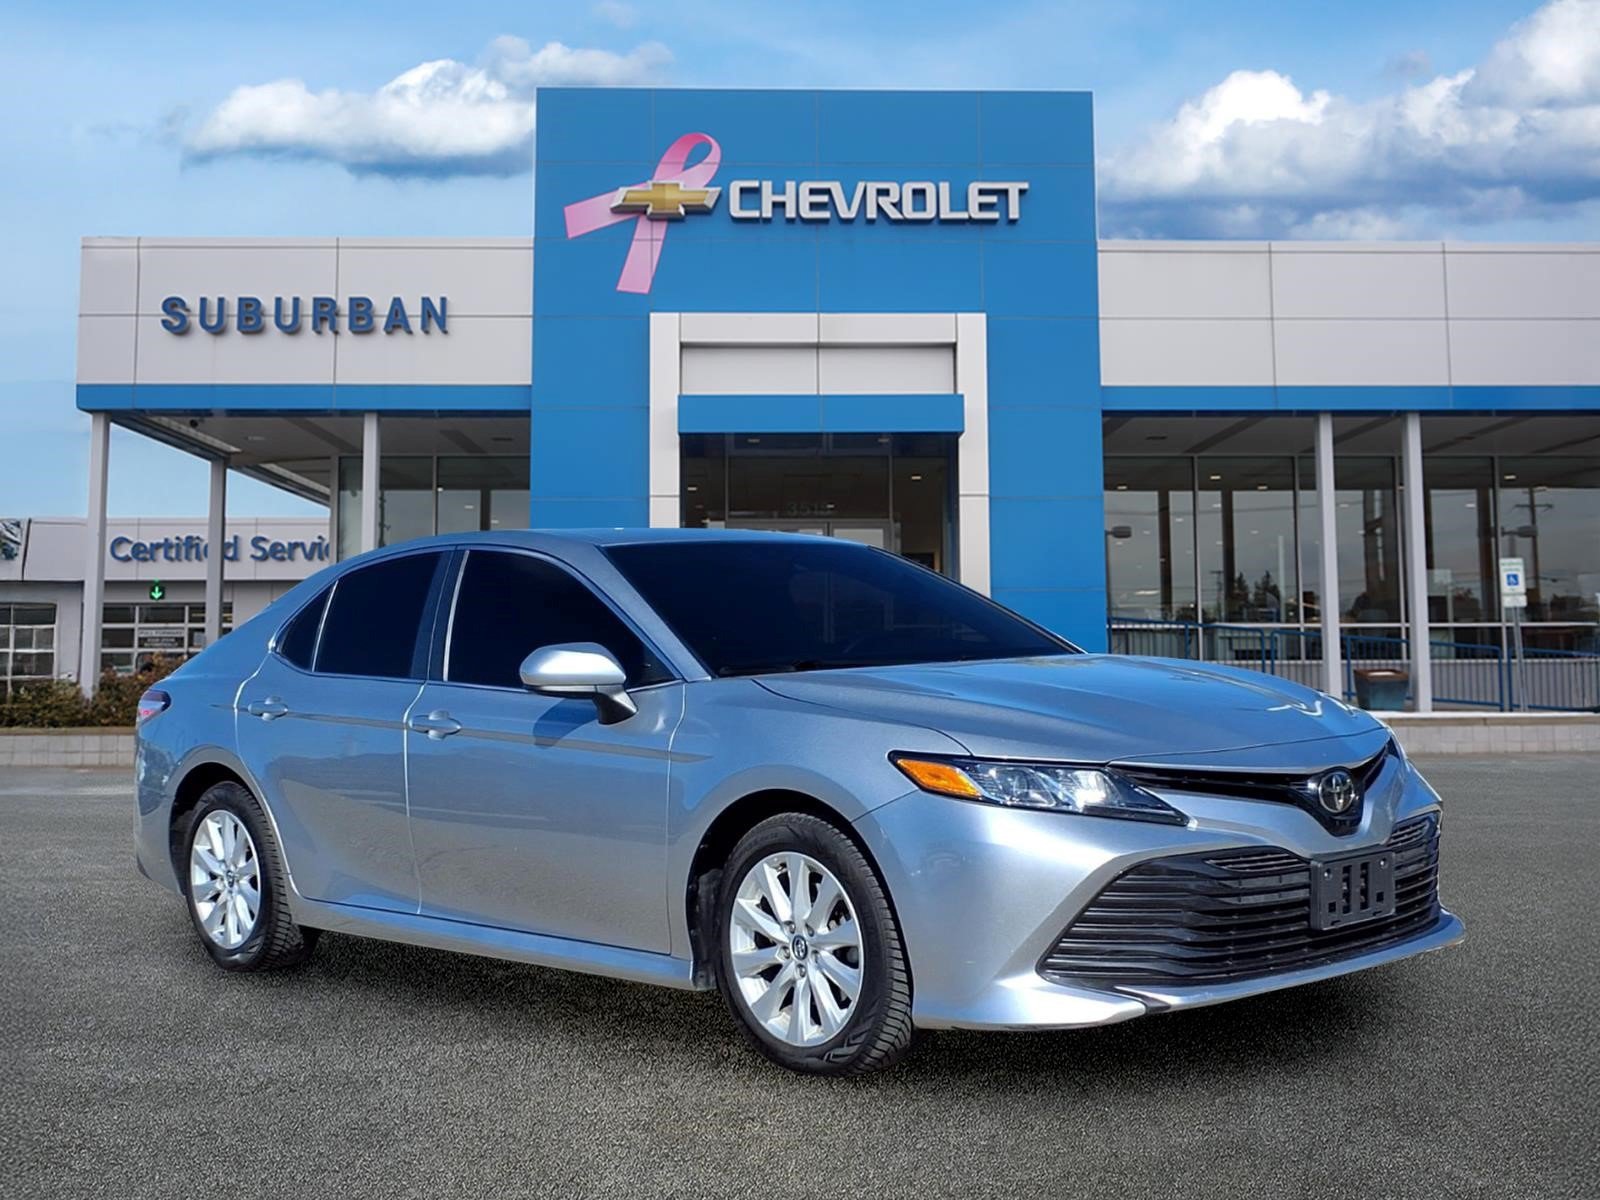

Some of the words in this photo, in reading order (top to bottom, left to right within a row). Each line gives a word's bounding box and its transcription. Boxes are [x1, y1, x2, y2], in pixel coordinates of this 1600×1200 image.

[729, 180, 1029, 220] CHEVROLET
[160, 296, 449, 335] SUBURBAN
[109, 535, 240, 562] Certifid
[250, 535, 330, 562] Servi
